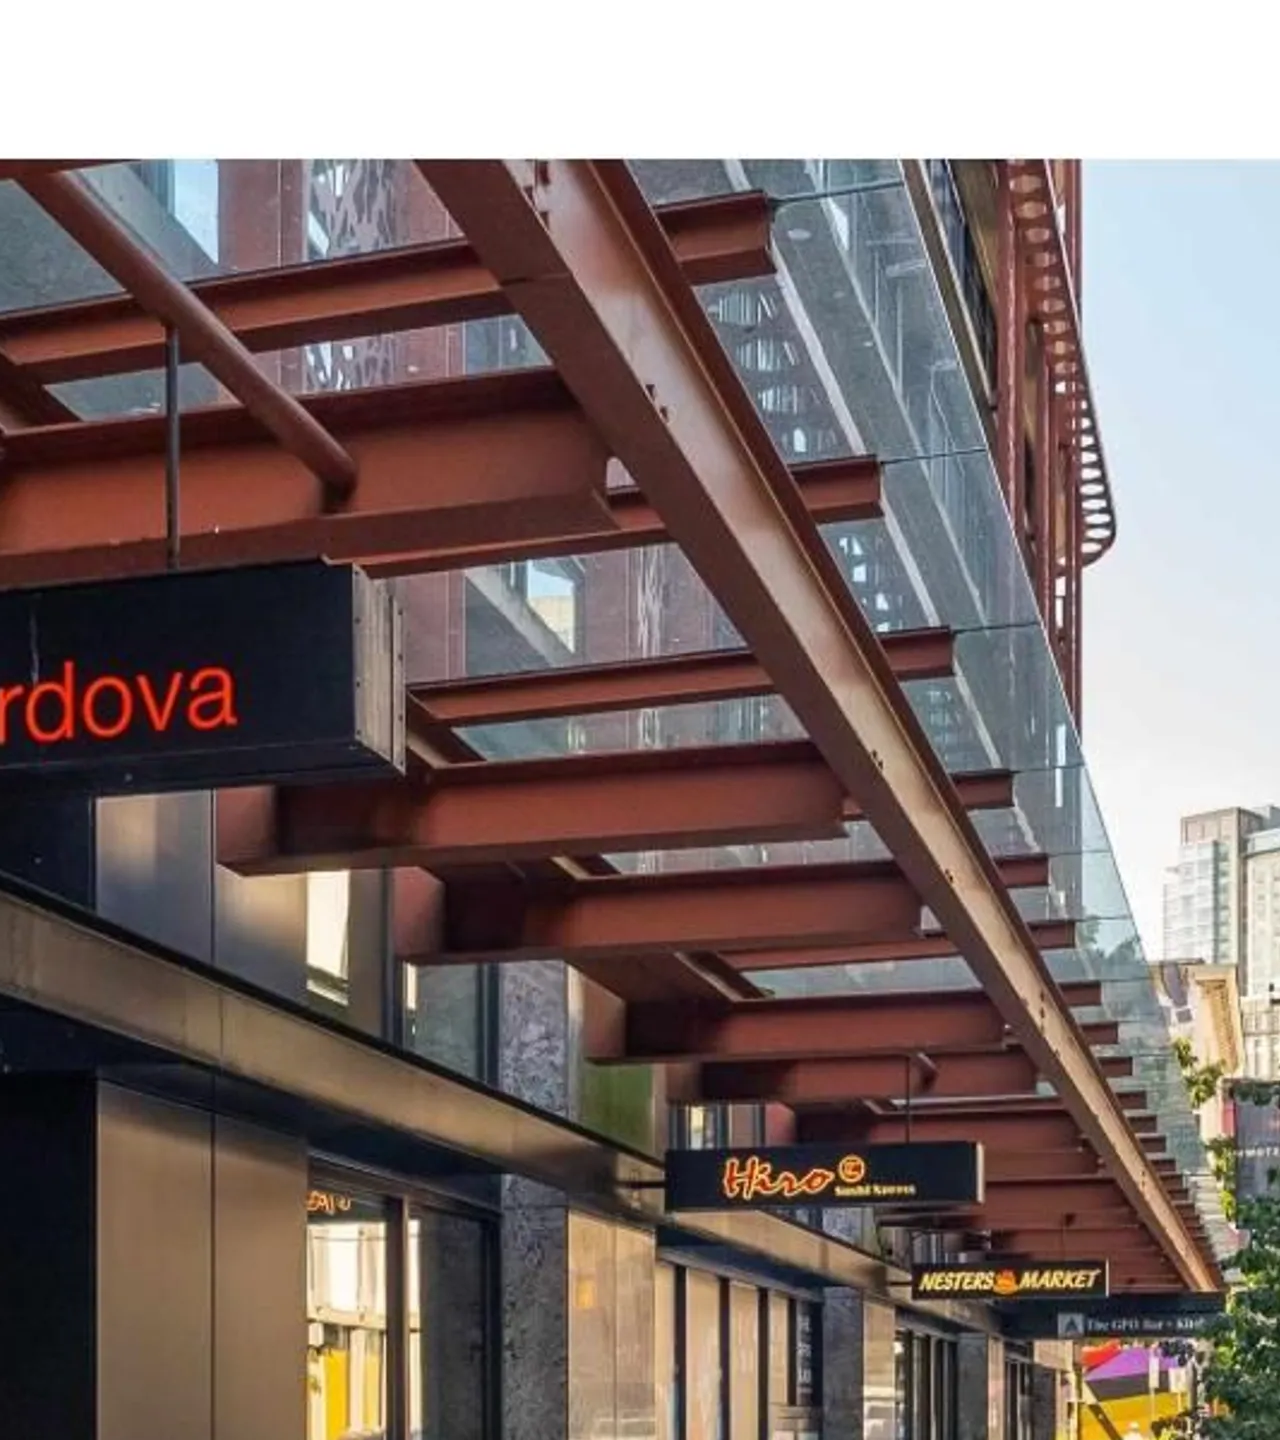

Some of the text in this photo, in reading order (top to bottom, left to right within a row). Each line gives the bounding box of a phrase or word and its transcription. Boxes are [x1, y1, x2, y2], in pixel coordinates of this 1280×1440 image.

[723, 1155, 836, 1200] Hiro
[918, 1268, 1103, 1291] NESTERS MARKET
